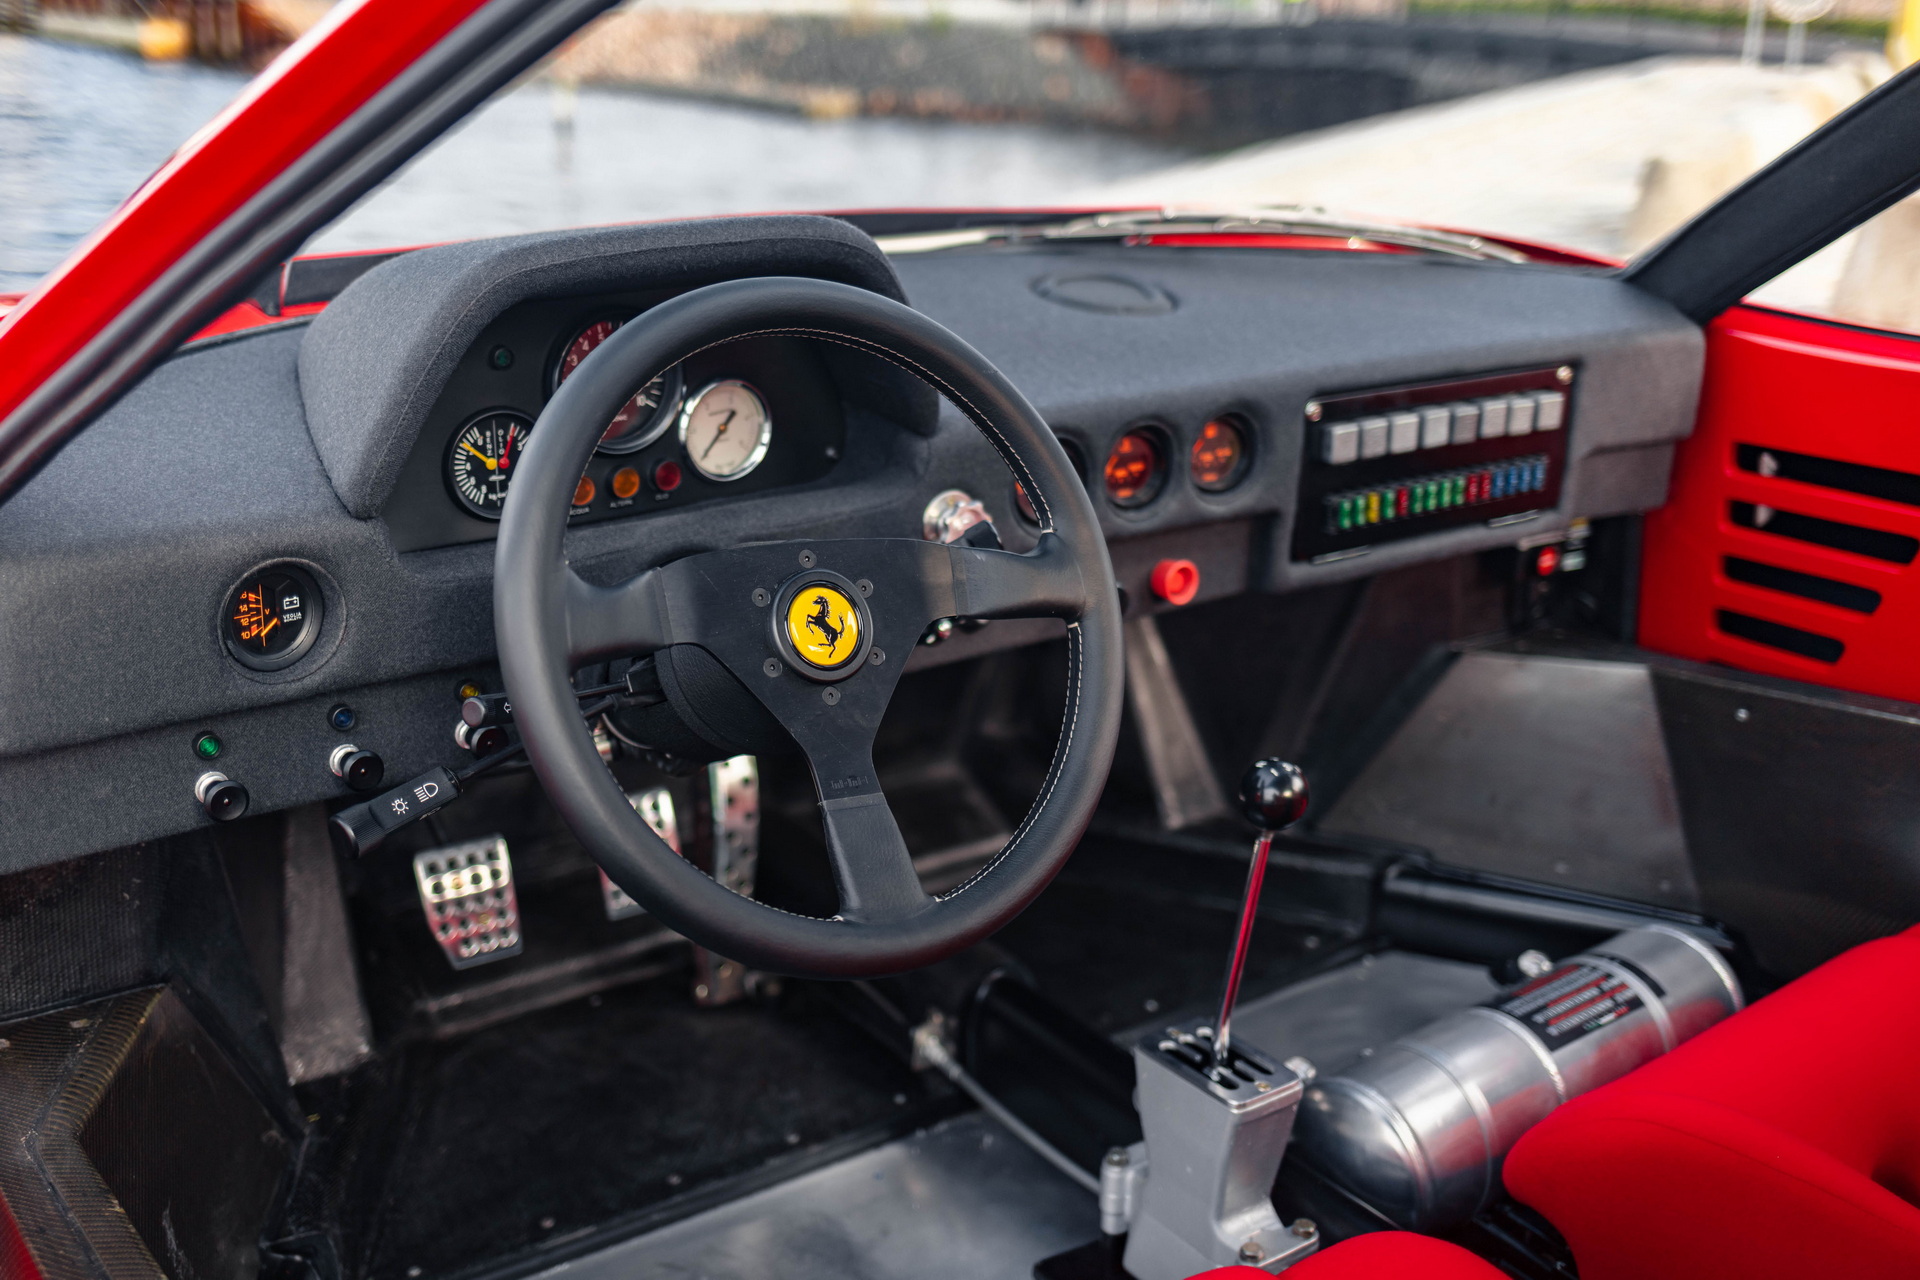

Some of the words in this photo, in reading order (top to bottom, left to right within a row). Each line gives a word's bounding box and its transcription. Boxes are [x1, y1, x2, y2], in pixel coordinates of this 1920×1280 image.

[582, 339, 590, 351] 4
[570, 354, 578, 366] 3
[239, 604, 248, 613] 14
[240, 617, 249, 626] 12
[241, 631, 250, 640] 10
